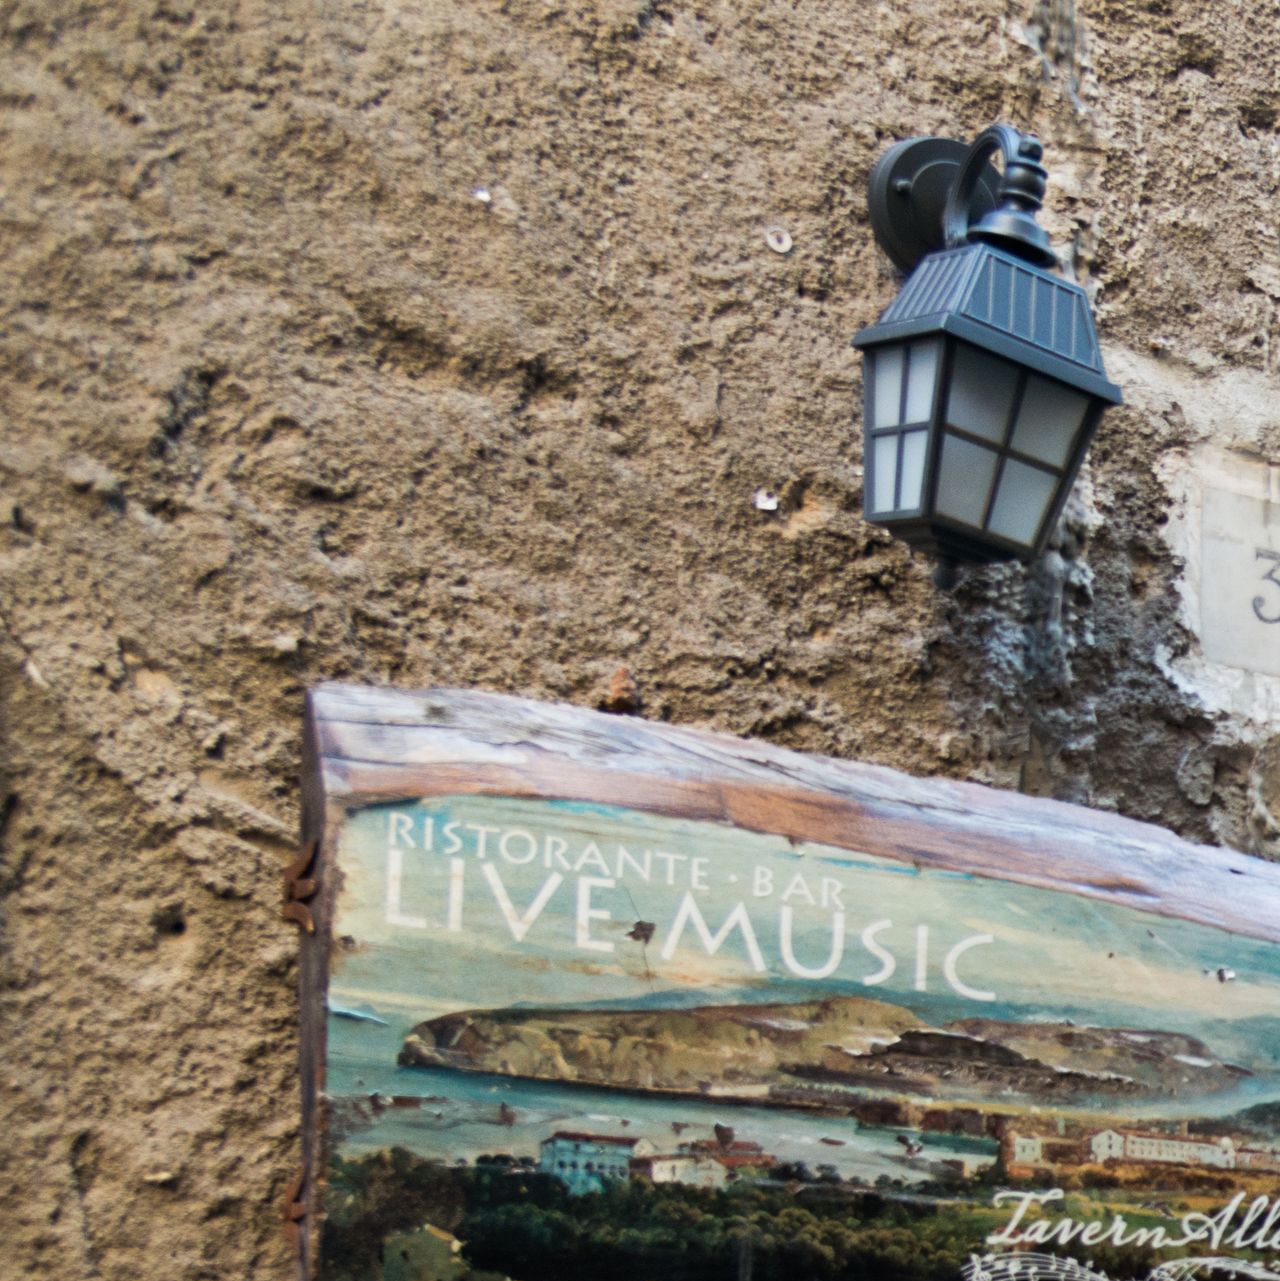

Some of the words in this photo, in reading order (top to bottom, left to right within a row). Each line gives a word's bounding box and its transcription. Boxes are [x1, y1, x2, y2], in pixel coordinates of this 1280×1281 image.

[385, 847, 617, 954] LIVE
[660, 890, 998, 1002] MUSIC
[386, 811, 711, 890] RISTORANTE
[751, 865, 847, 911] BAR
